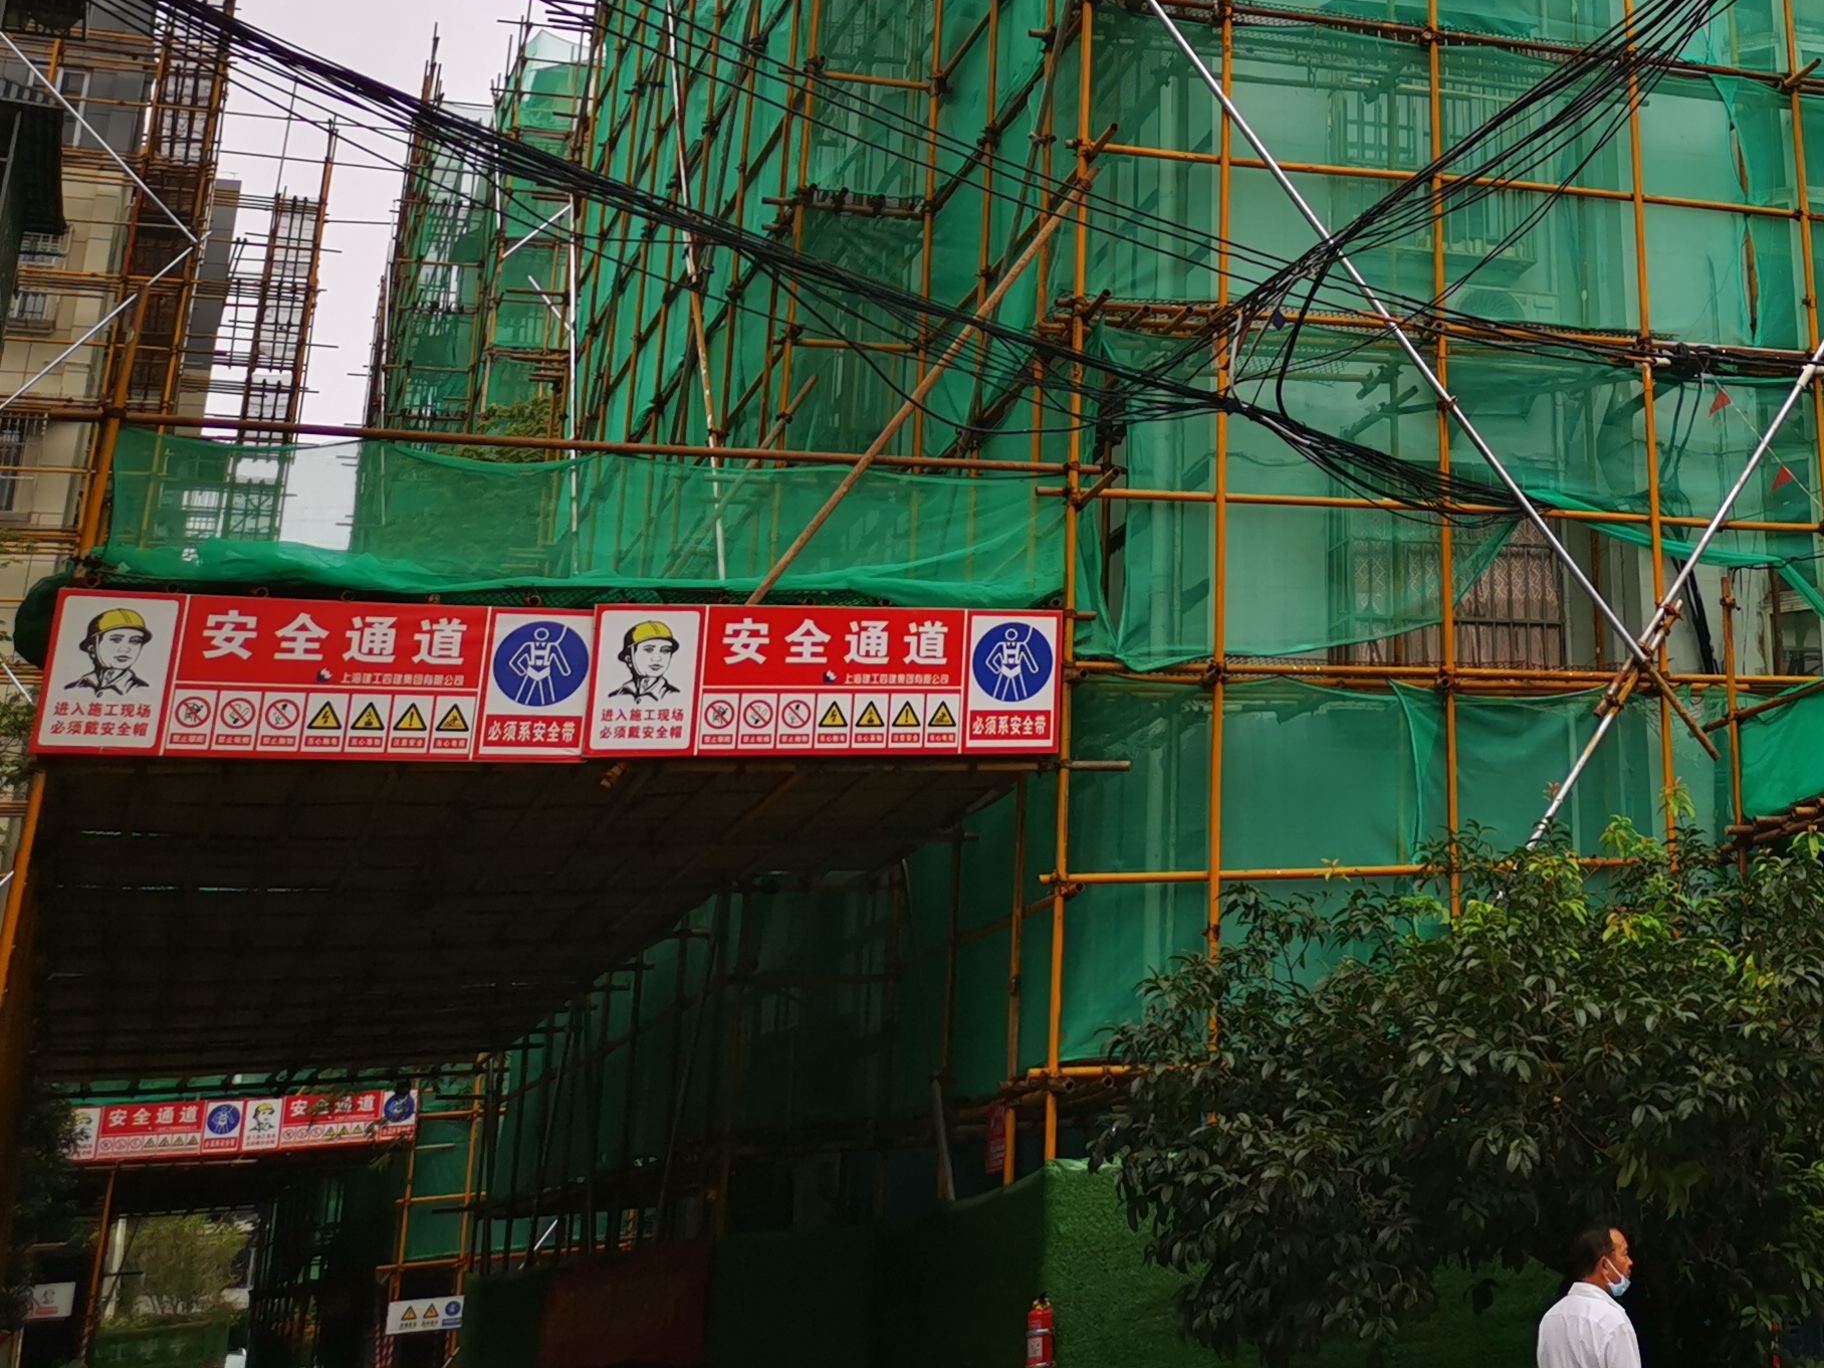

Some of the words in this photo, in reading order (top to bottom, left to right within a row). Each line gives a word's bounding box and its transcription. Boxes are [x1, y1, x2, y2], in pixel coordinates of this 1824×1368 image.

[203, 610, 465, 666] 安全通道
[722, 618, 949, 666] 安全通道
[53, 701, 152, 718] 进入施工现场
[600, 708, 684, 723] 进入施工现场
[50, 720, 149, 737] 必须戴安全帽
[487, 719, 576, 743] 必须系安全带
[599, 725, 683, 739] 必须戴安全帽
[972, 715, 1046, 735] 必须系安全带
[108, 1105, 199, 1128] 安全通道
